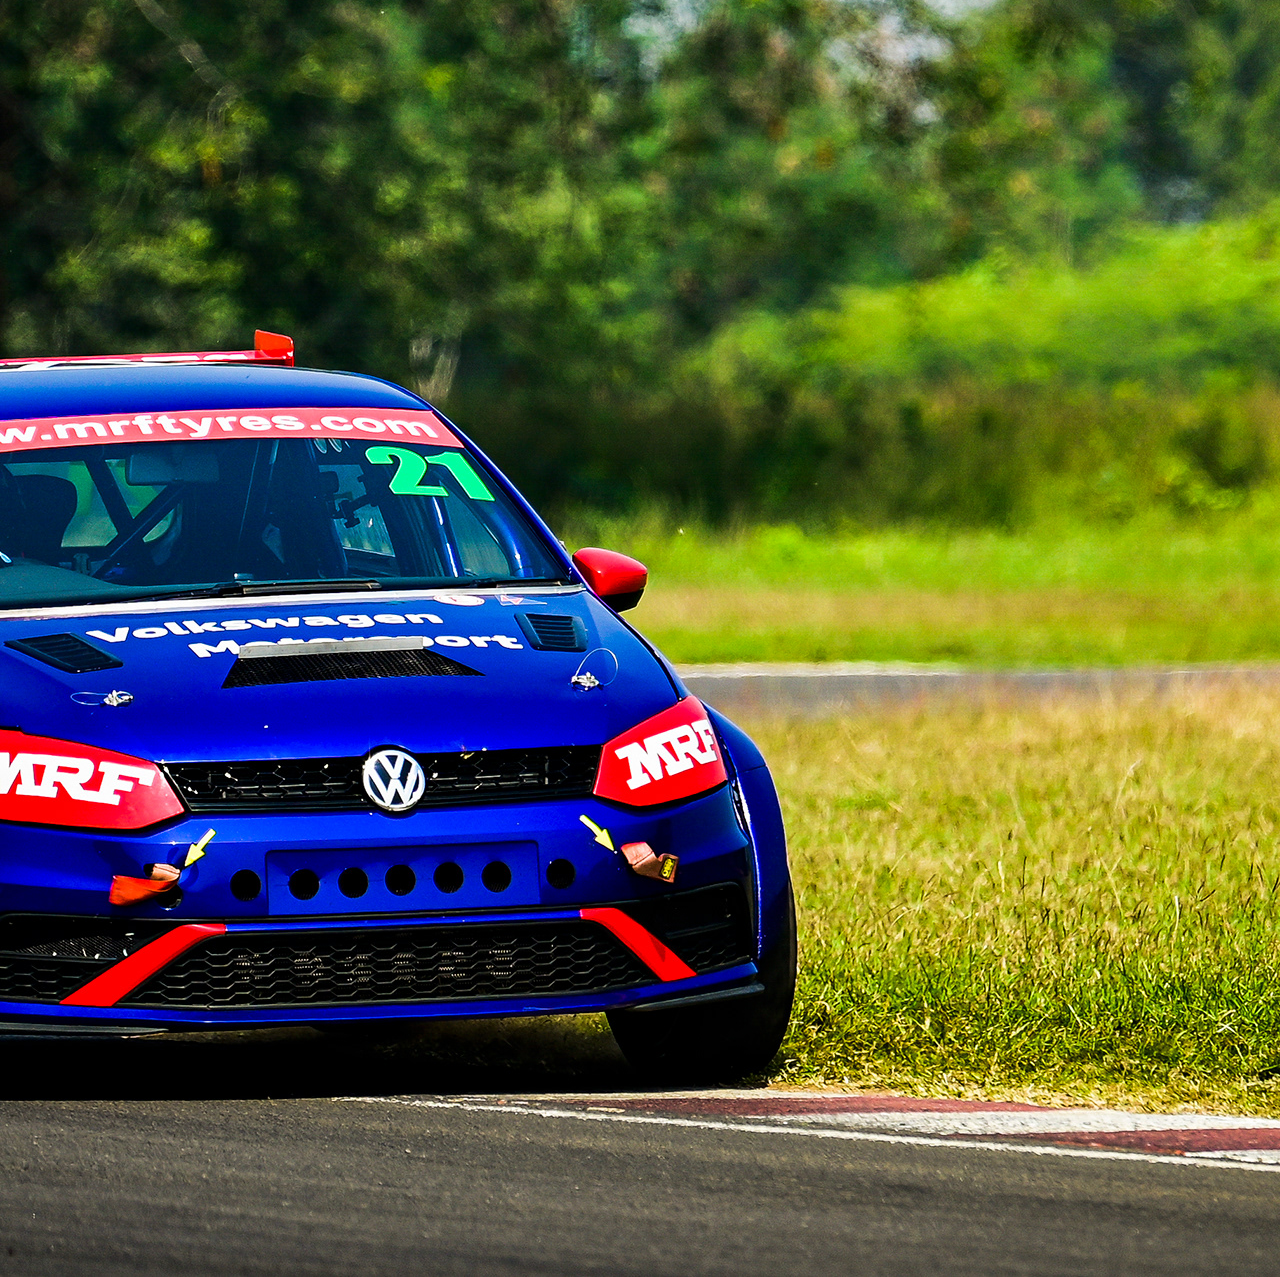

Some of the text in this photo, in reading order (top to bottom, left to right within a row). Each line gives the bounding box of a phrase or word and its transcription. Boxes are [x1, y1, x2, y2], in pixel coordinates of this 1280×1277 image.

[365, 446, 495, 501] 21
[86, 612, 444, 644] Volkswagen
[614, 719, 718, 790] MRF
